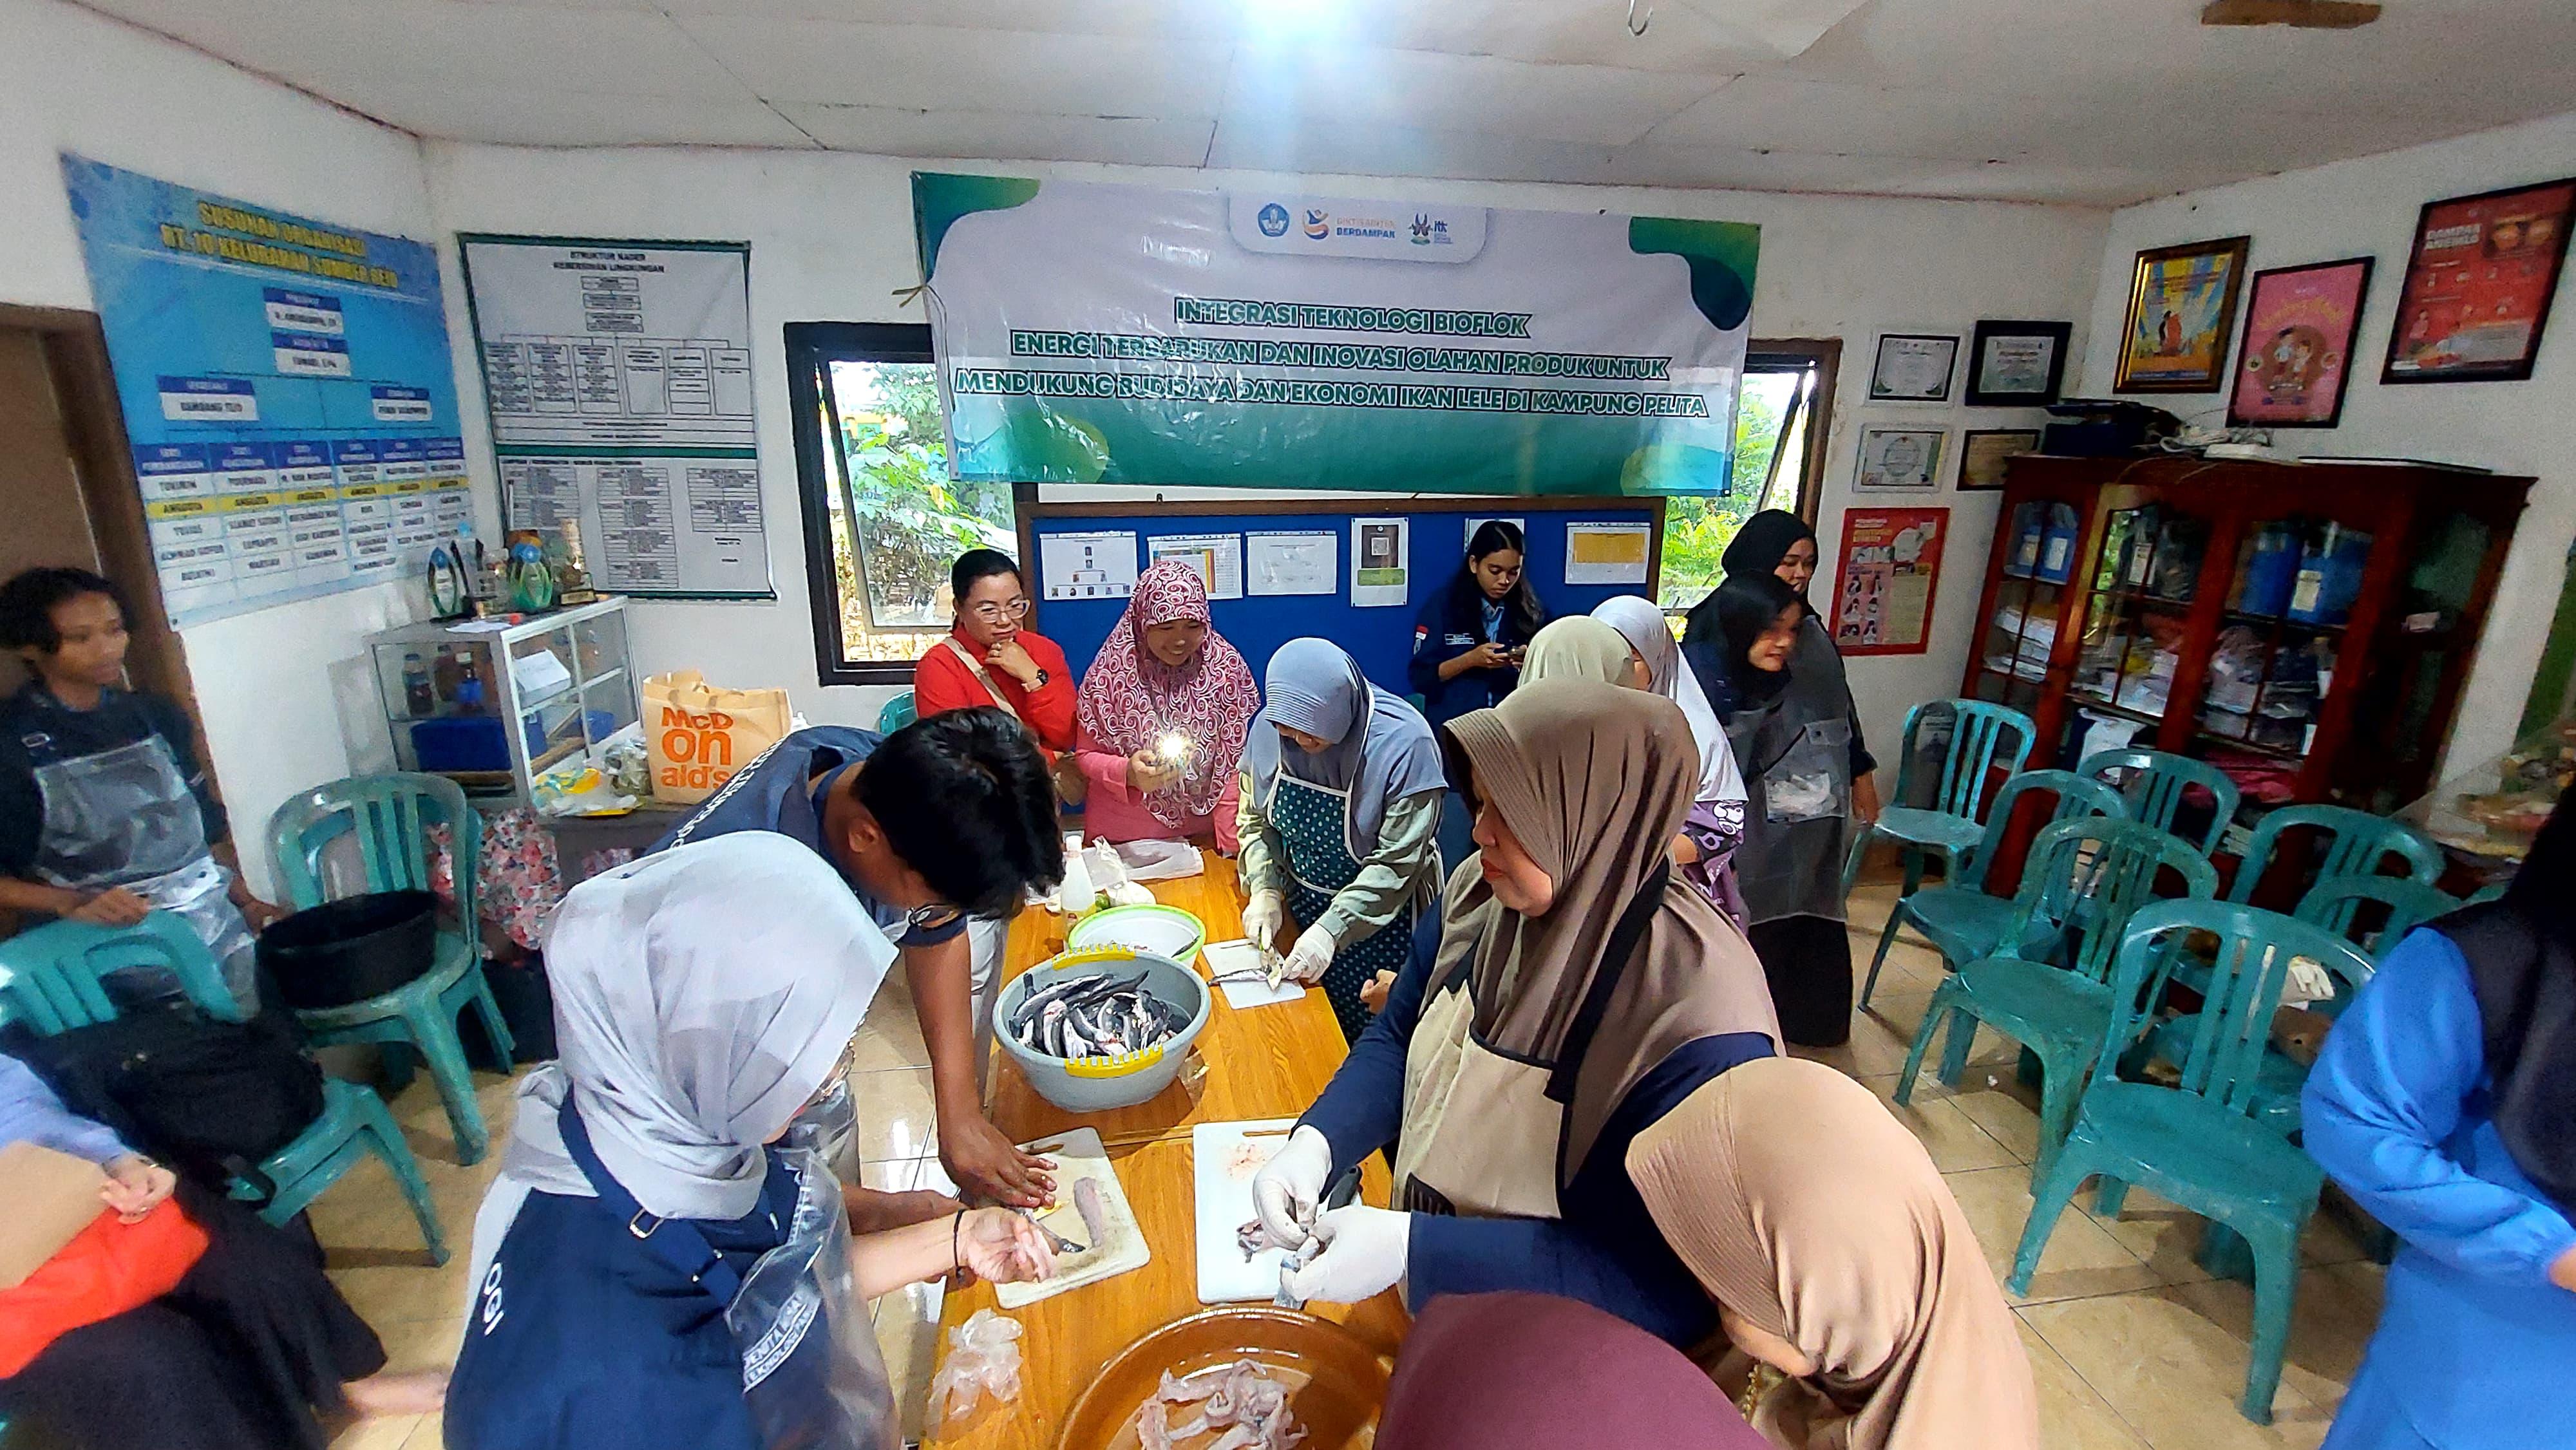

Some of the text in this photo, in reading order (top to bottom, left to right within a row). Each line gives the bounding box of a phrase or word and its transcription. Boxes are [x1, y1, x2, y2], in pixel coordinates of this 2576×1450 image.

[1336, 227, 1396, 238] BERDAMPAK
[1176, 298, 1530, 337] INTEGRASI TEKNOLOGI BIOFLOK
[1012, 332, 1099, 357] ENERGI
[1262, 343, 1311, 366] DAN
[1313, 345, 1405, 370] INOVASI
[1406, 349, 1501, 374] OLAHAN
[1504, 353, 1593, 377] PRODUK
[1594, 357, 1669, 381] UNTUK
[956, 369, 1709, 418] MENDUKUNG BUDIDAYA DAN EKONOMI IKAN LELE DI KAMPUNG PELITA
[661, 707, 734, 730] McD
[661, 728, 732, 766] on
